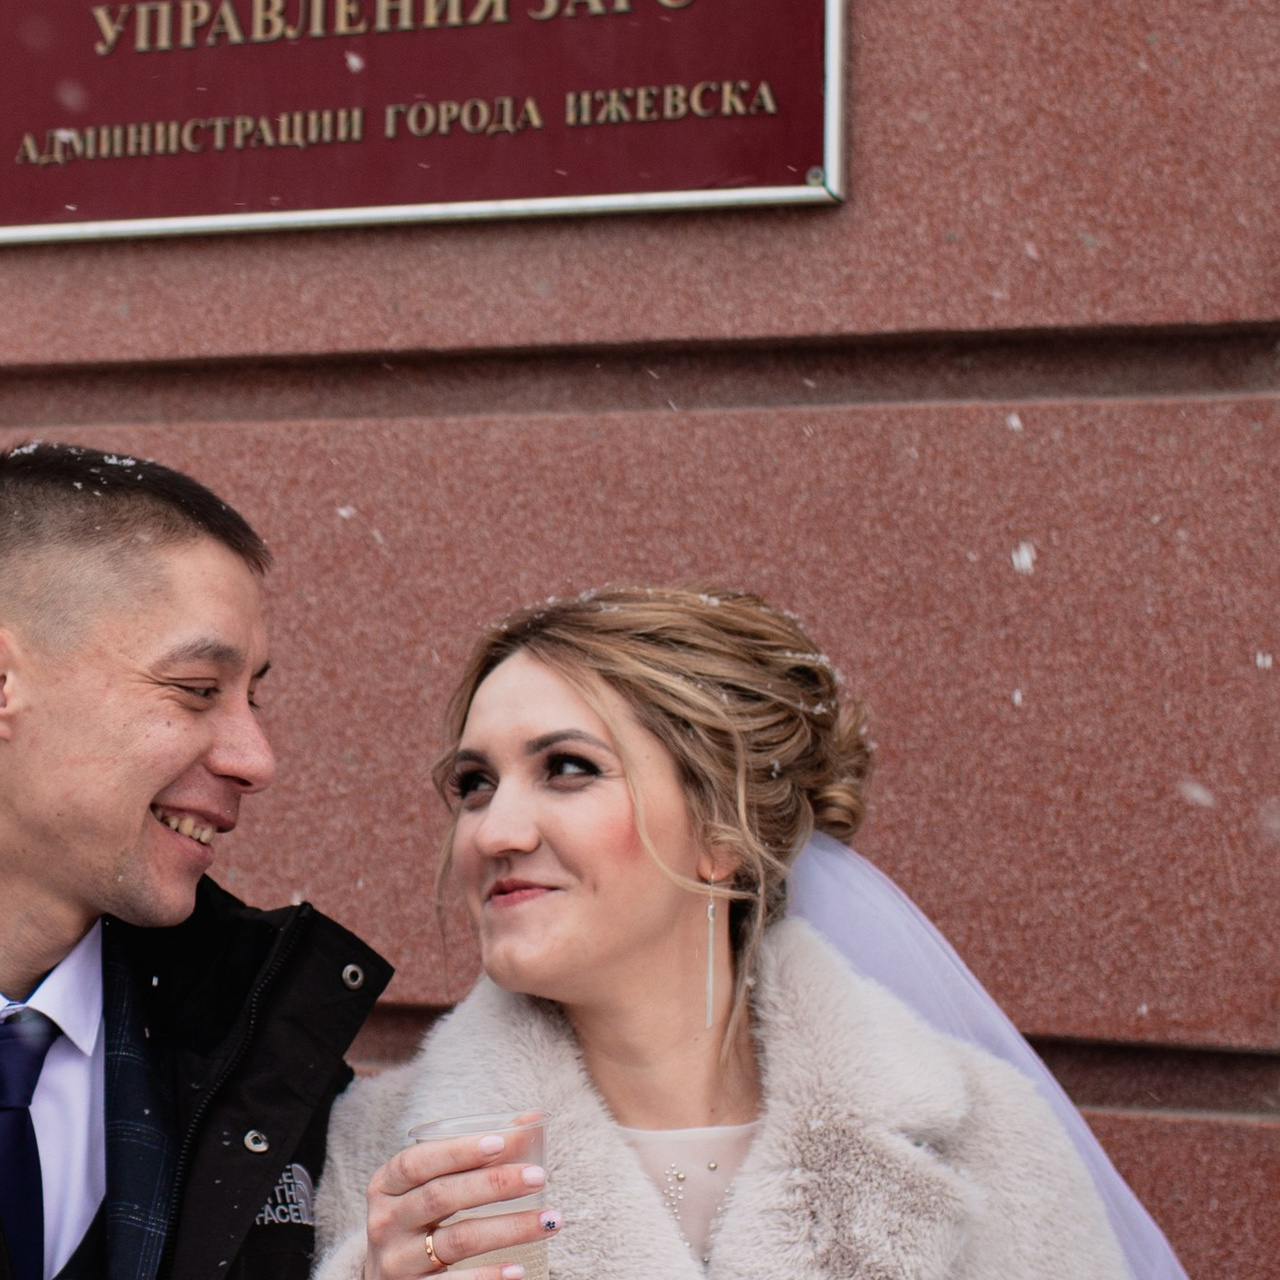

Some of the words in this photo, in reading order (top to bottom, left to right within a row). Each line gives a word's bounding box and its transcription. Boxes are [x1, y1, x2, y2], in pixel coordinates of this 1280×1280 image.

[16, 107, 363, 165] АДМИНИСТРАЦИИ
[384, 96, 543, 138] ГОРОДА
[565, 80, 778, 126] ИЖЕВСКА
